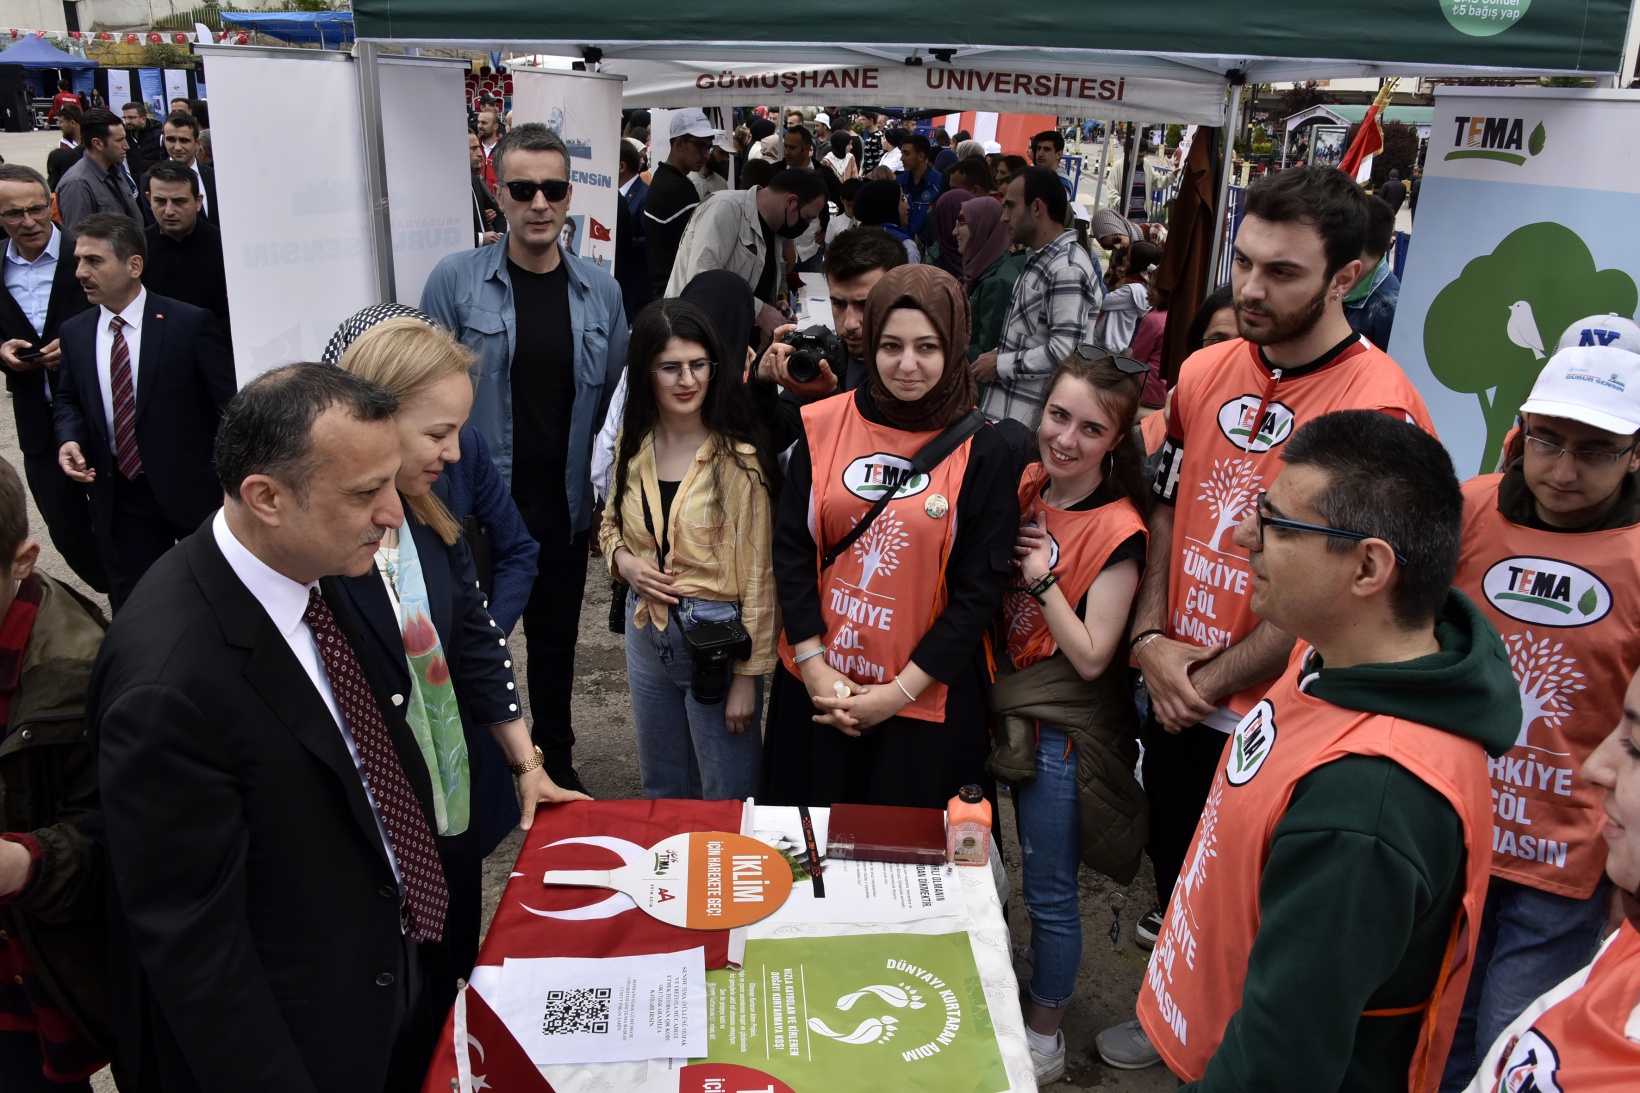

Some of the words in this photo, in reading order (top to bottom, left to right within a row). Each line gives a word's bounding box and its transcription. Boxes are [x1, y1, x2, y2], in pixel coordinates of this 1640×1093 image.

[1468, 5, 1498, 20] bağış
[1500, 9, 1520, 21] yap
[695, 68, 879, 93] GÜMÜŞHANE
[1454, 116, 1524, 150] TEMA
[864, 463, 910, 487] TEMA
[1508, 565, 1571, 603] TEMA
[830, 586, 894, 631] TÜRKİYE
[1186, 584, 1217, 620] ÇÖL
[826, 649, 885, 683] MASIN
[1241, 707, 1264, 763] TEMA
[1486, 753, 1573, 797] RKİYE
[658, 854, 670, 871] TEMA
[706, 841, 724, 855] İÇİN
[707, 857, 722, 896] HAREKETE
[732, 855, 770, 903] İKLİM
[931, 877, 945, 901] OLMANIN
[706, 898, 722, 916] GEÇ!
[917, 878, 934, 908] DİKMEKTİR.
[771, 971, 782, 992] DOĞAYI
[783, 968, 793, 985] HIZLA
[886, 958, 946, 989] DÜNYAYI
[772, 993, 784, 1034] KURTARMAYA
[785, 985, 795, 1015] KAYBOLAN
[664, 1018, 670, 1027] QR
[787, 1016, 796, 1024] VE
[936, 989, 961, 1046] KURTARAN
[773, 1034, 785, 1050] KOŞ!
[788, 1025, 799, 1056] KİRLENEN
[901, 1041, 941, 1062] ADIM
